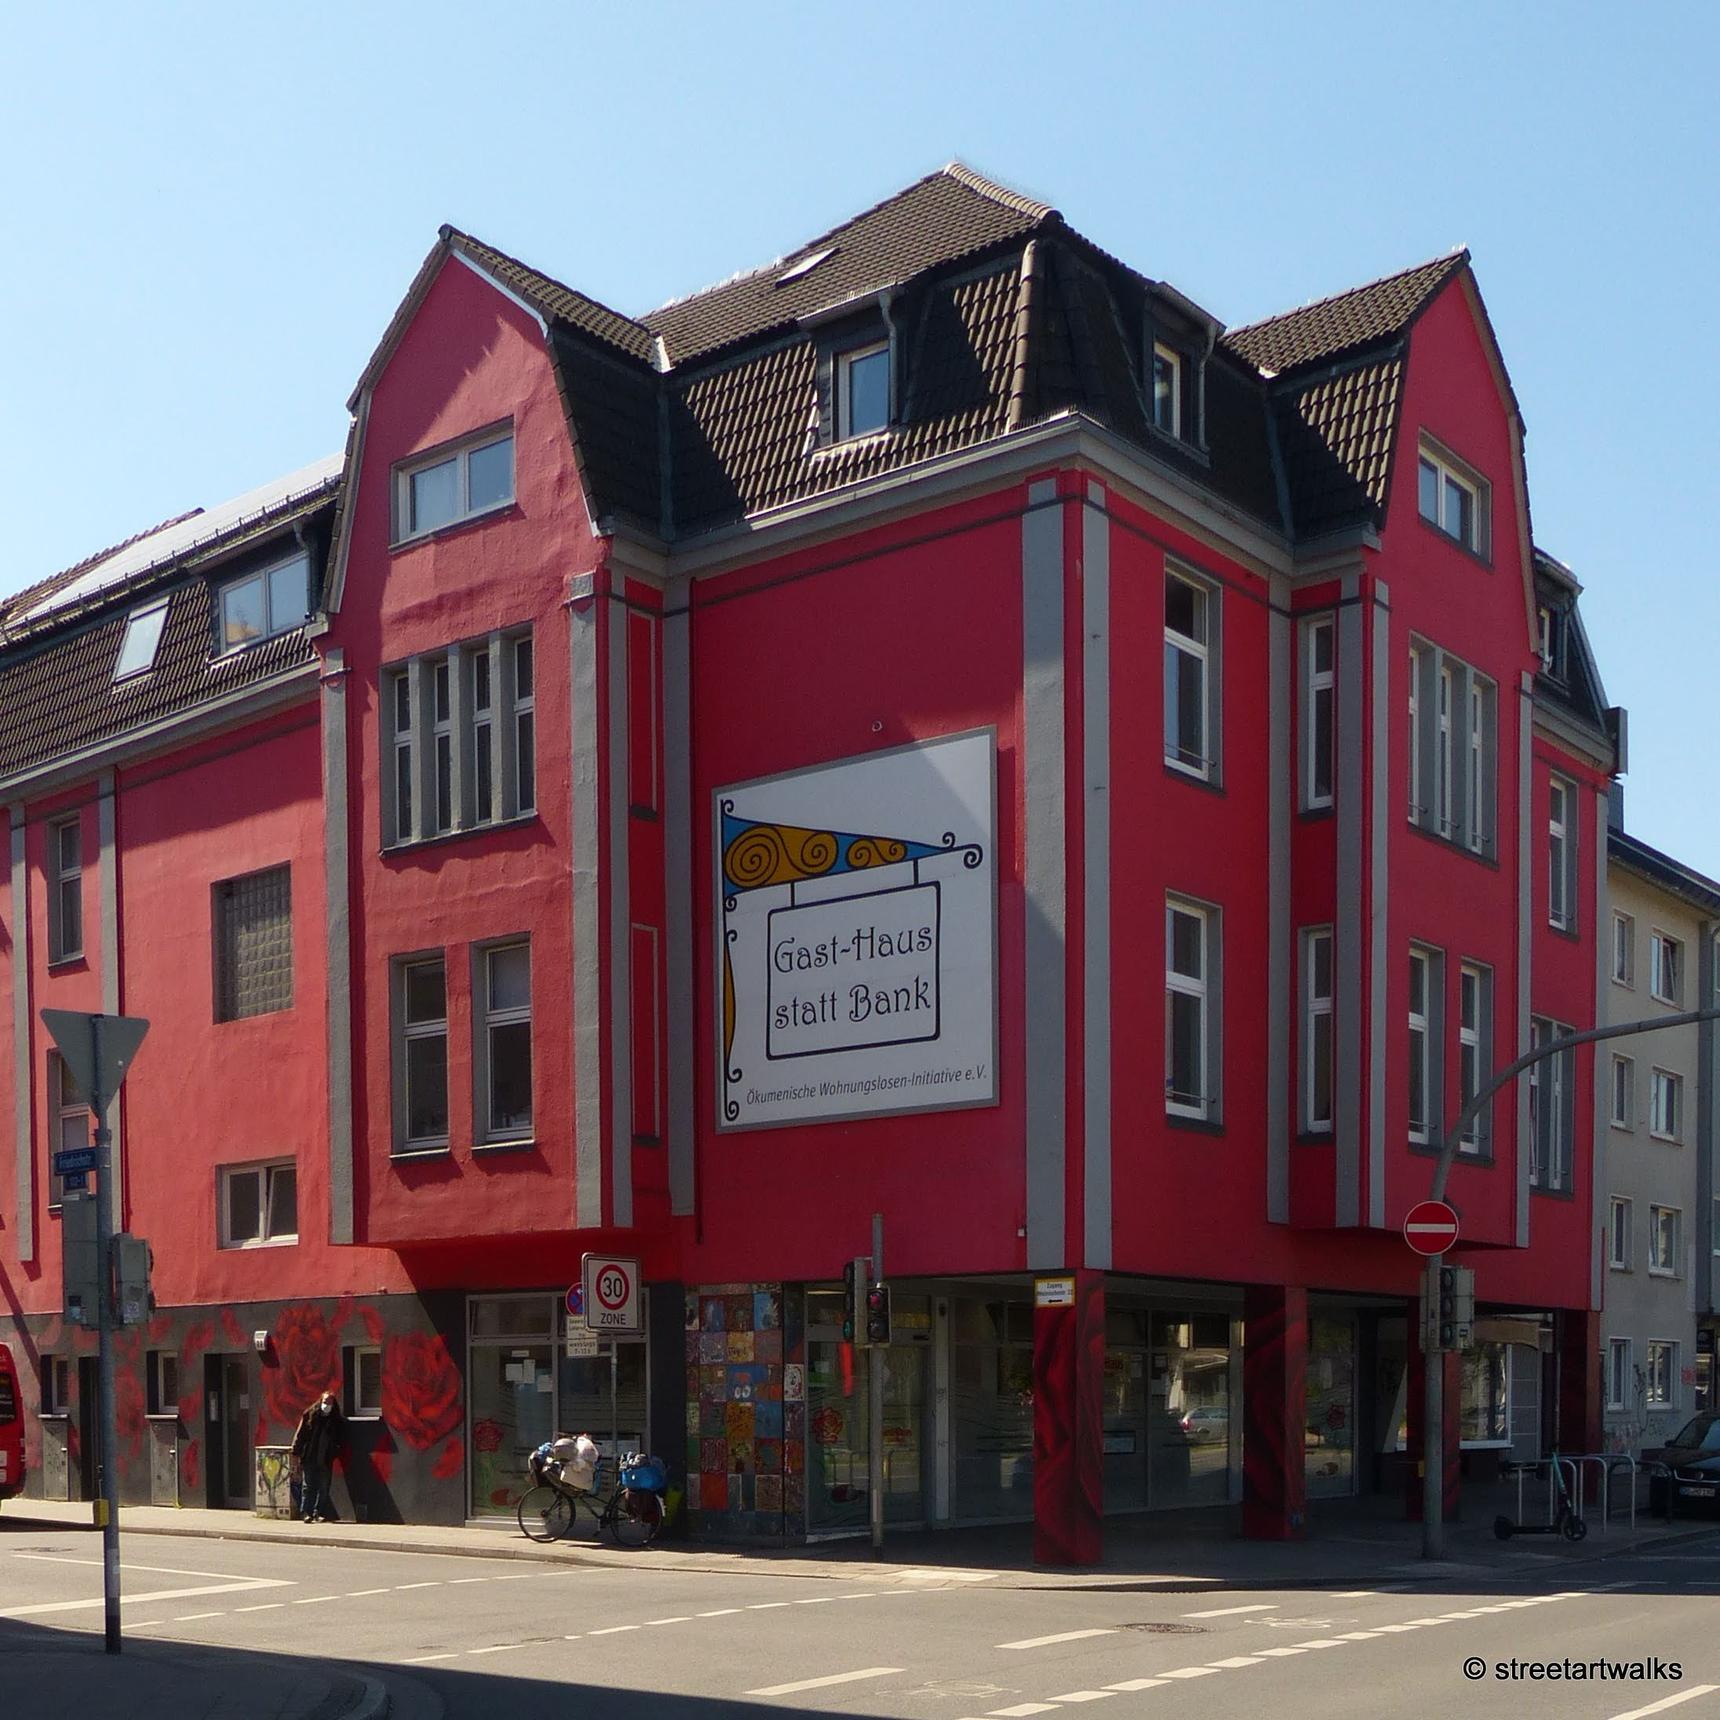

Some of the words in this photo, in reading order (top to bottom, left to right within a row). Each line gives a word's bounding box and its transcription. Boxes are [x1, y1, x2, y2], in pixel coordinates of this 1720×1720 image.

[774, 926, 933, 973] Gast-Haus
[774, 990, 838, 1029] statt
[849, 975, 931, 1022] Bank
[746, 1084, 817, 1105] Ökumenische
[819, 1068, 962, 1096] Wohnungslosen-Initiative
[965, 1064, 988, 1080] e.V.
[603, 1276, 623, 1298] 30
[600, 1313, 627, 1325] ZONE
